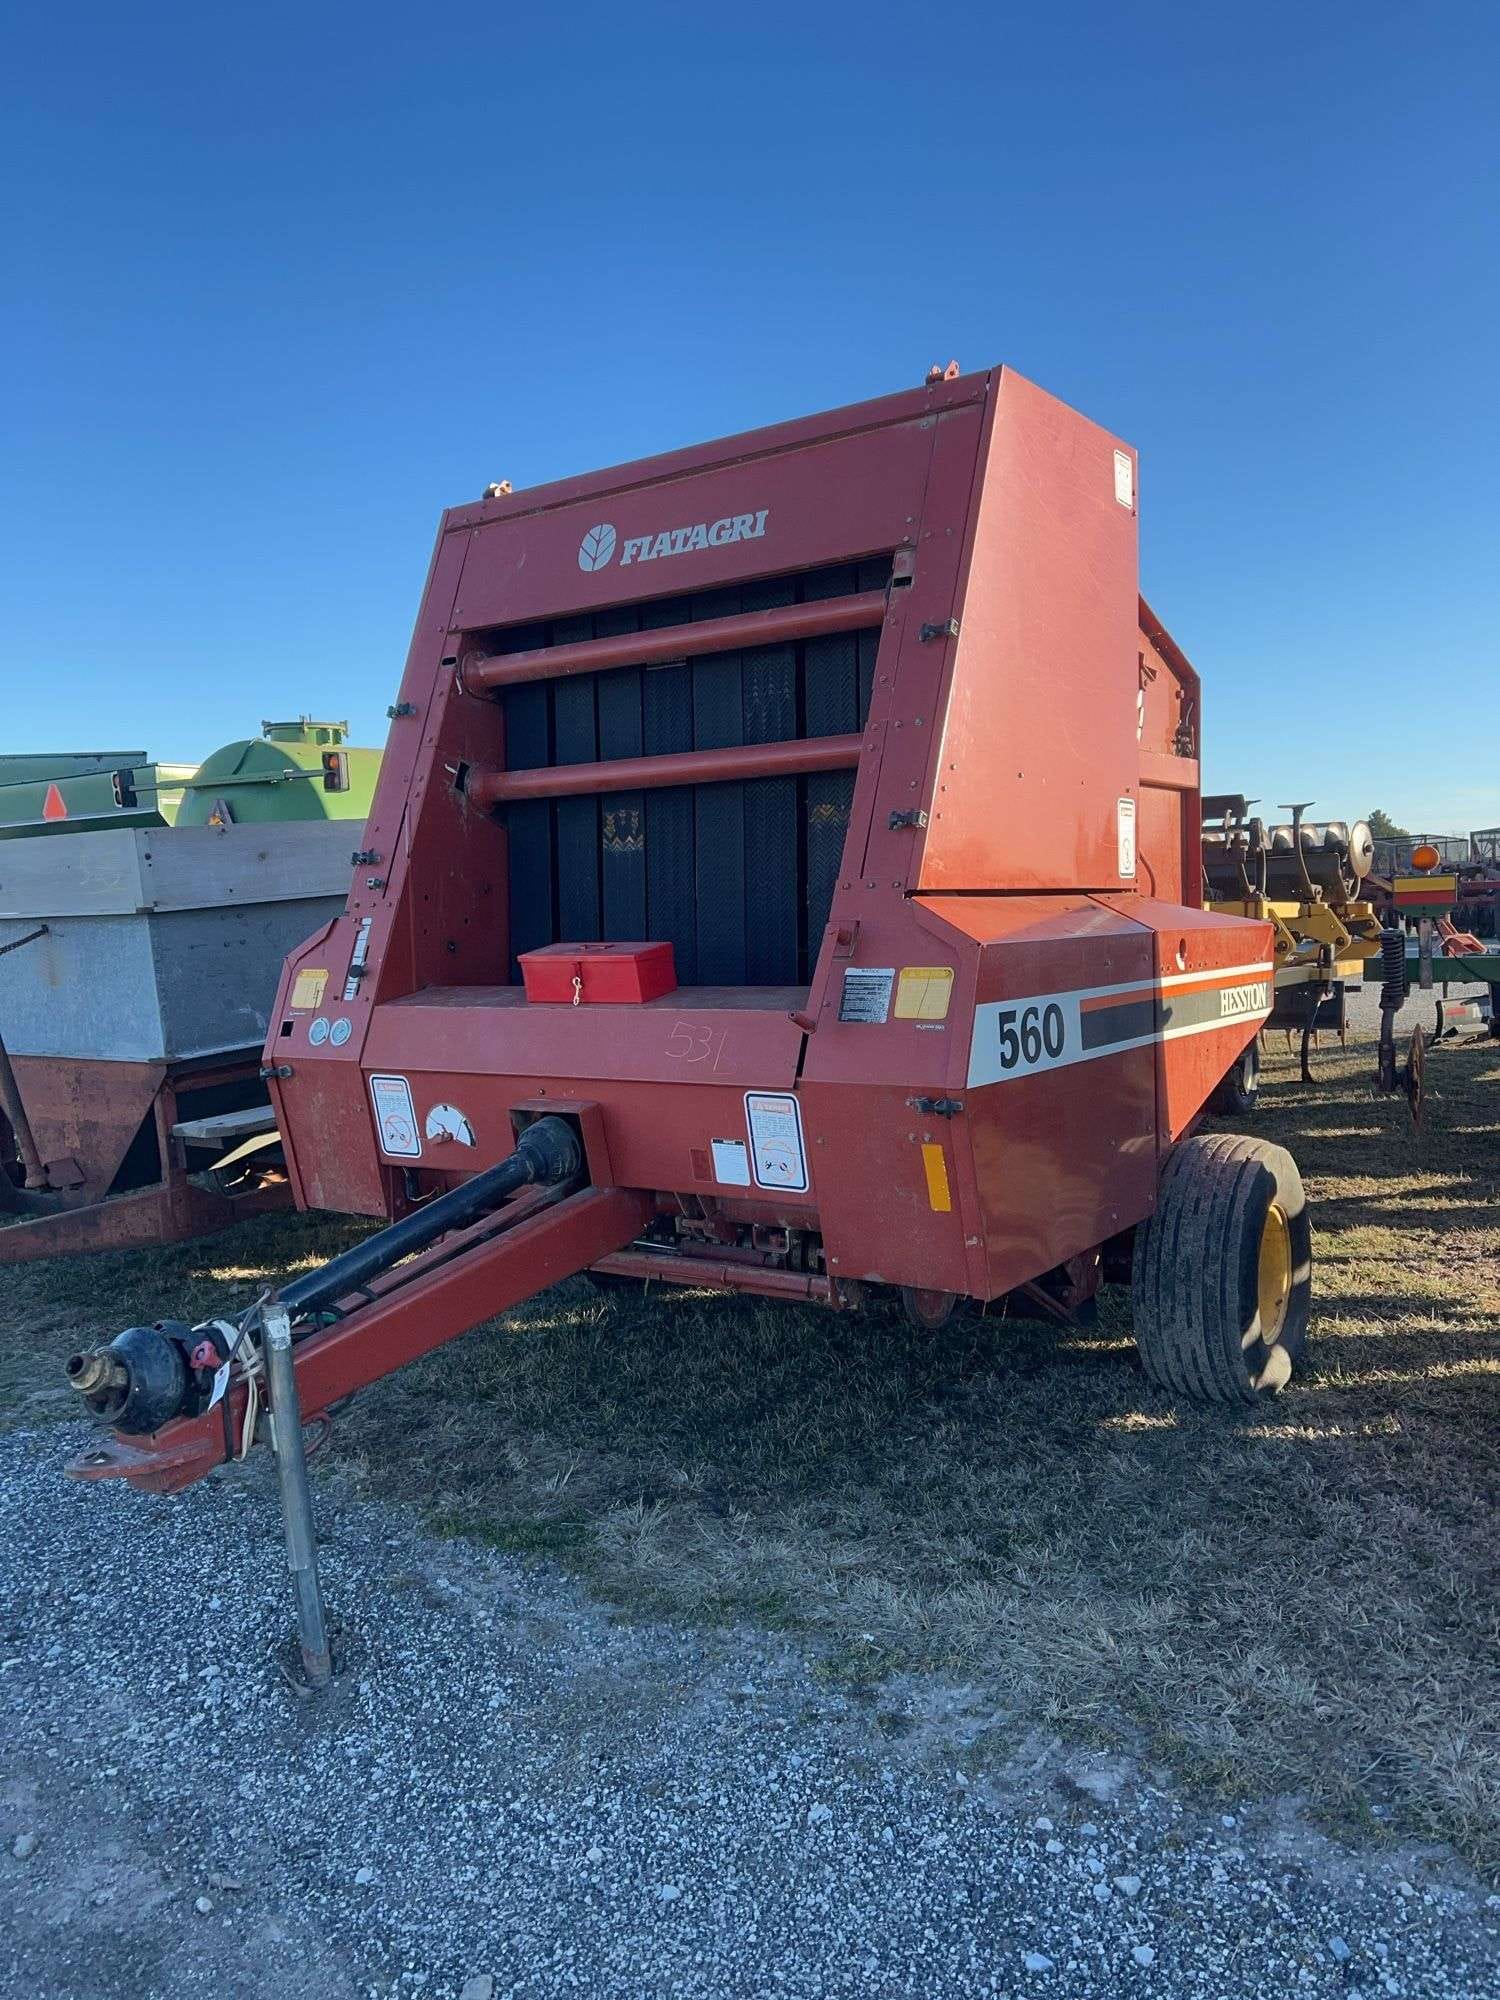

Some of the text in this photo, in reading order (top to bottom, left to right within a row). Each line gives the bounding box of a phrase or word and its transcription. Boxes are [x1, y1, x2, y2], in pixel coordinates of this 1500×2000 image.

[619, 509, 769, 566] FIATAGRI
[1219, 981, 1268, 1017] HESSTON
[999, 1003, 1065, 1069] 560
